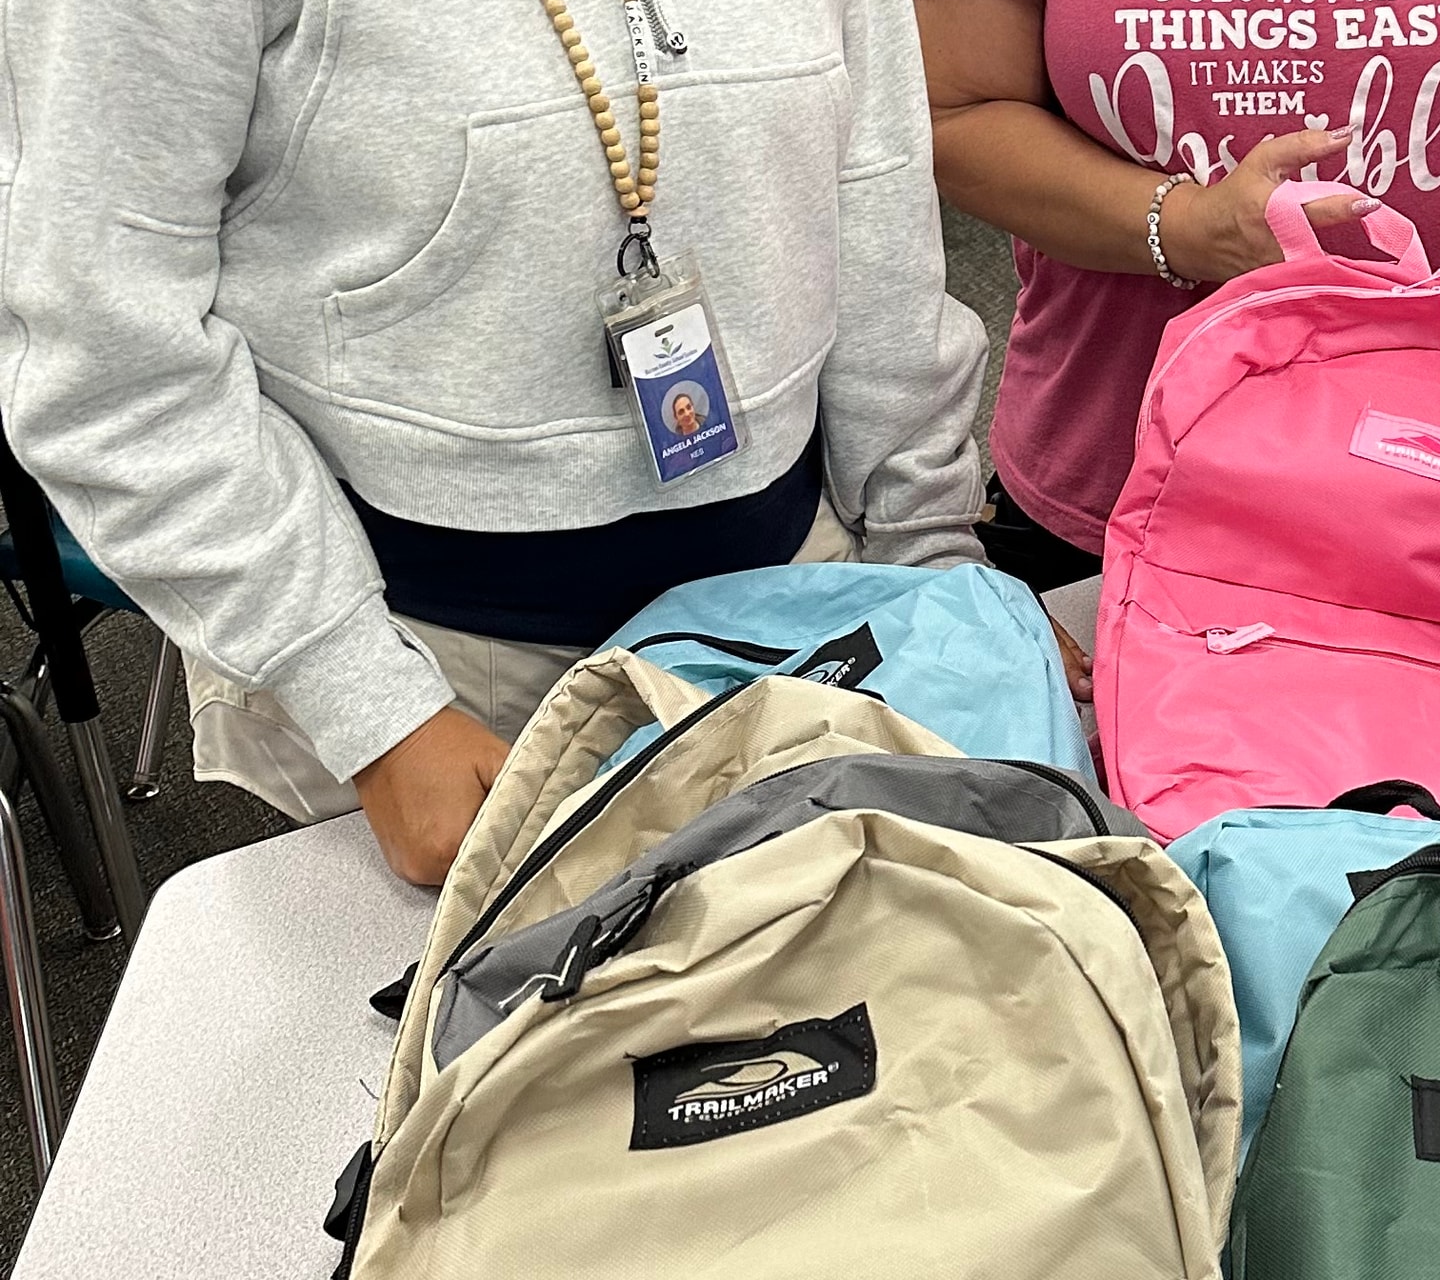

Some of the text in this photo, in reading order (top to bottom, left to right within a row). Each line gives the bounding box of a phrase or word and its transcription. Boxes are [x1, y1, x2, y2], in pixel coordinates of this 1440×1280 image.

[1115, 9, 1318, 51] THINGS
[1189, 60, 1325, 86] IT MAKES
[1212, 91, 1306, 116] THEM
[662, 422, 727, 459] ANGELA JACKSON
